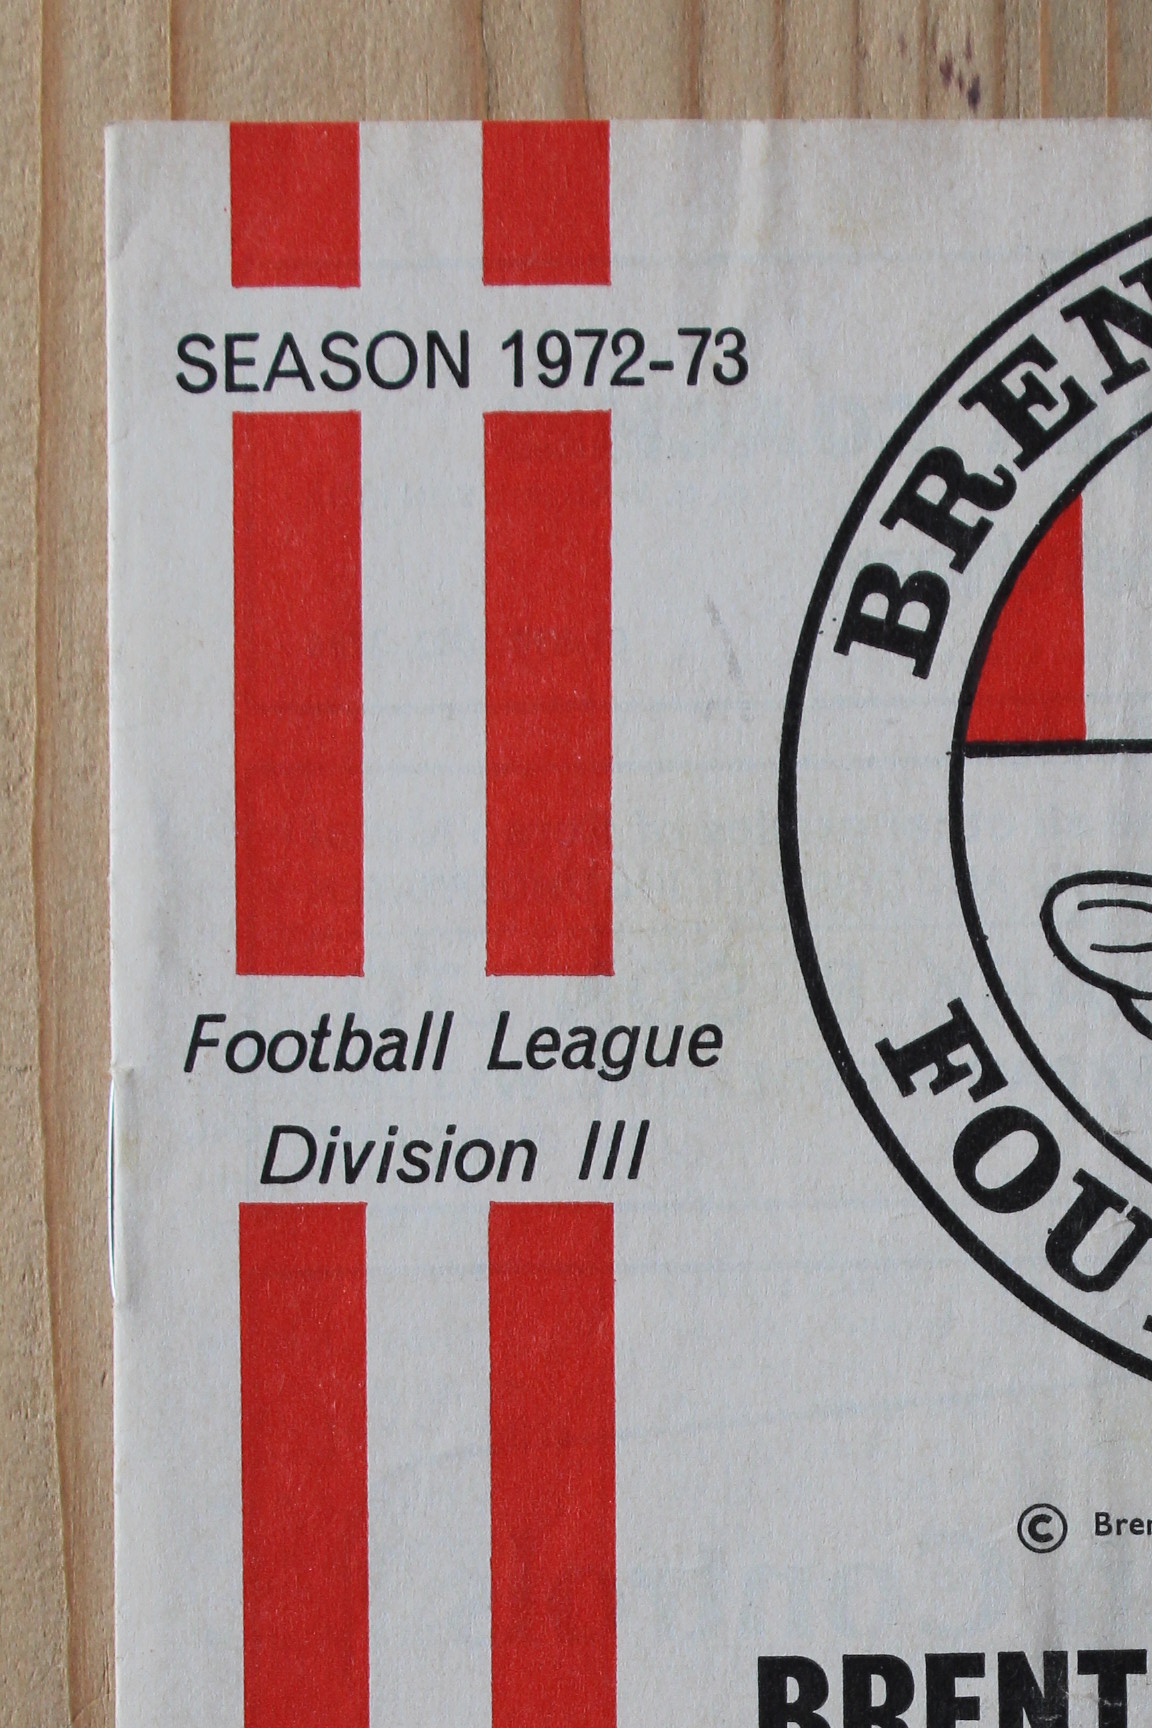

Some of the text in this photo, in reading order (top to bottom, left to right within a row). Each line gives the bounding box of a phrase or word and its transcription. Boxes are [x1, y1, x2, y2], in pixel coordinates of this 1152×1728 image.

[174, 325, 750, 396] SEASON 1972-73
[182, 1009, 725, 1084] Football League
[258, 1118, 652, 1186] Division III
